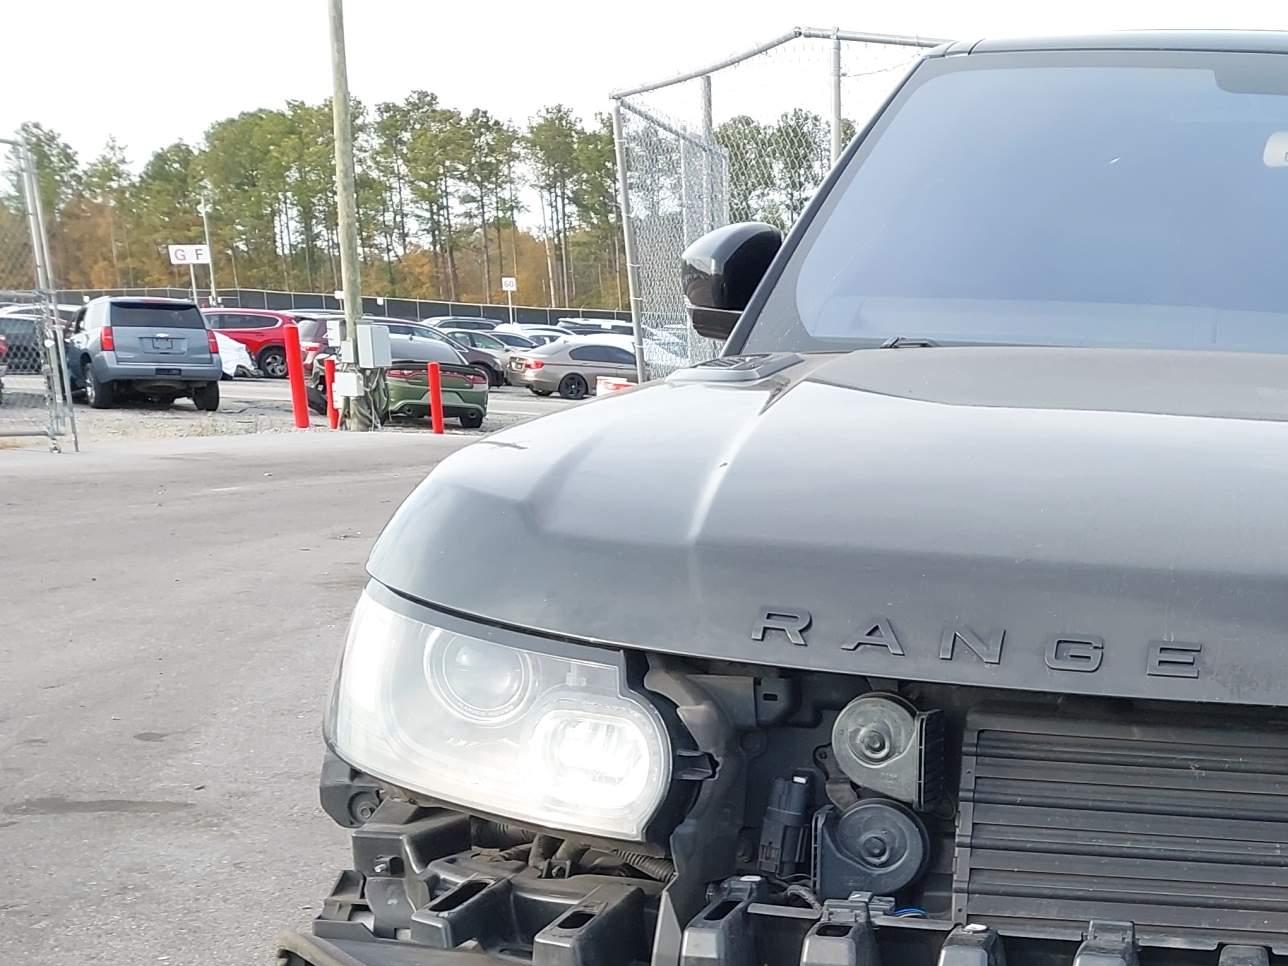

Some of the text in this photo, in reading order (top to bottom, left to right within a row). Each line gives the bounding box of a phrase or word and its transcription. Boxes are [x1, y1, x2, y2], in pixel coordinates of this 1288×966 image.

[174, 248, 204, 261] G F
[751, 605, 1203, 680] RANGE
